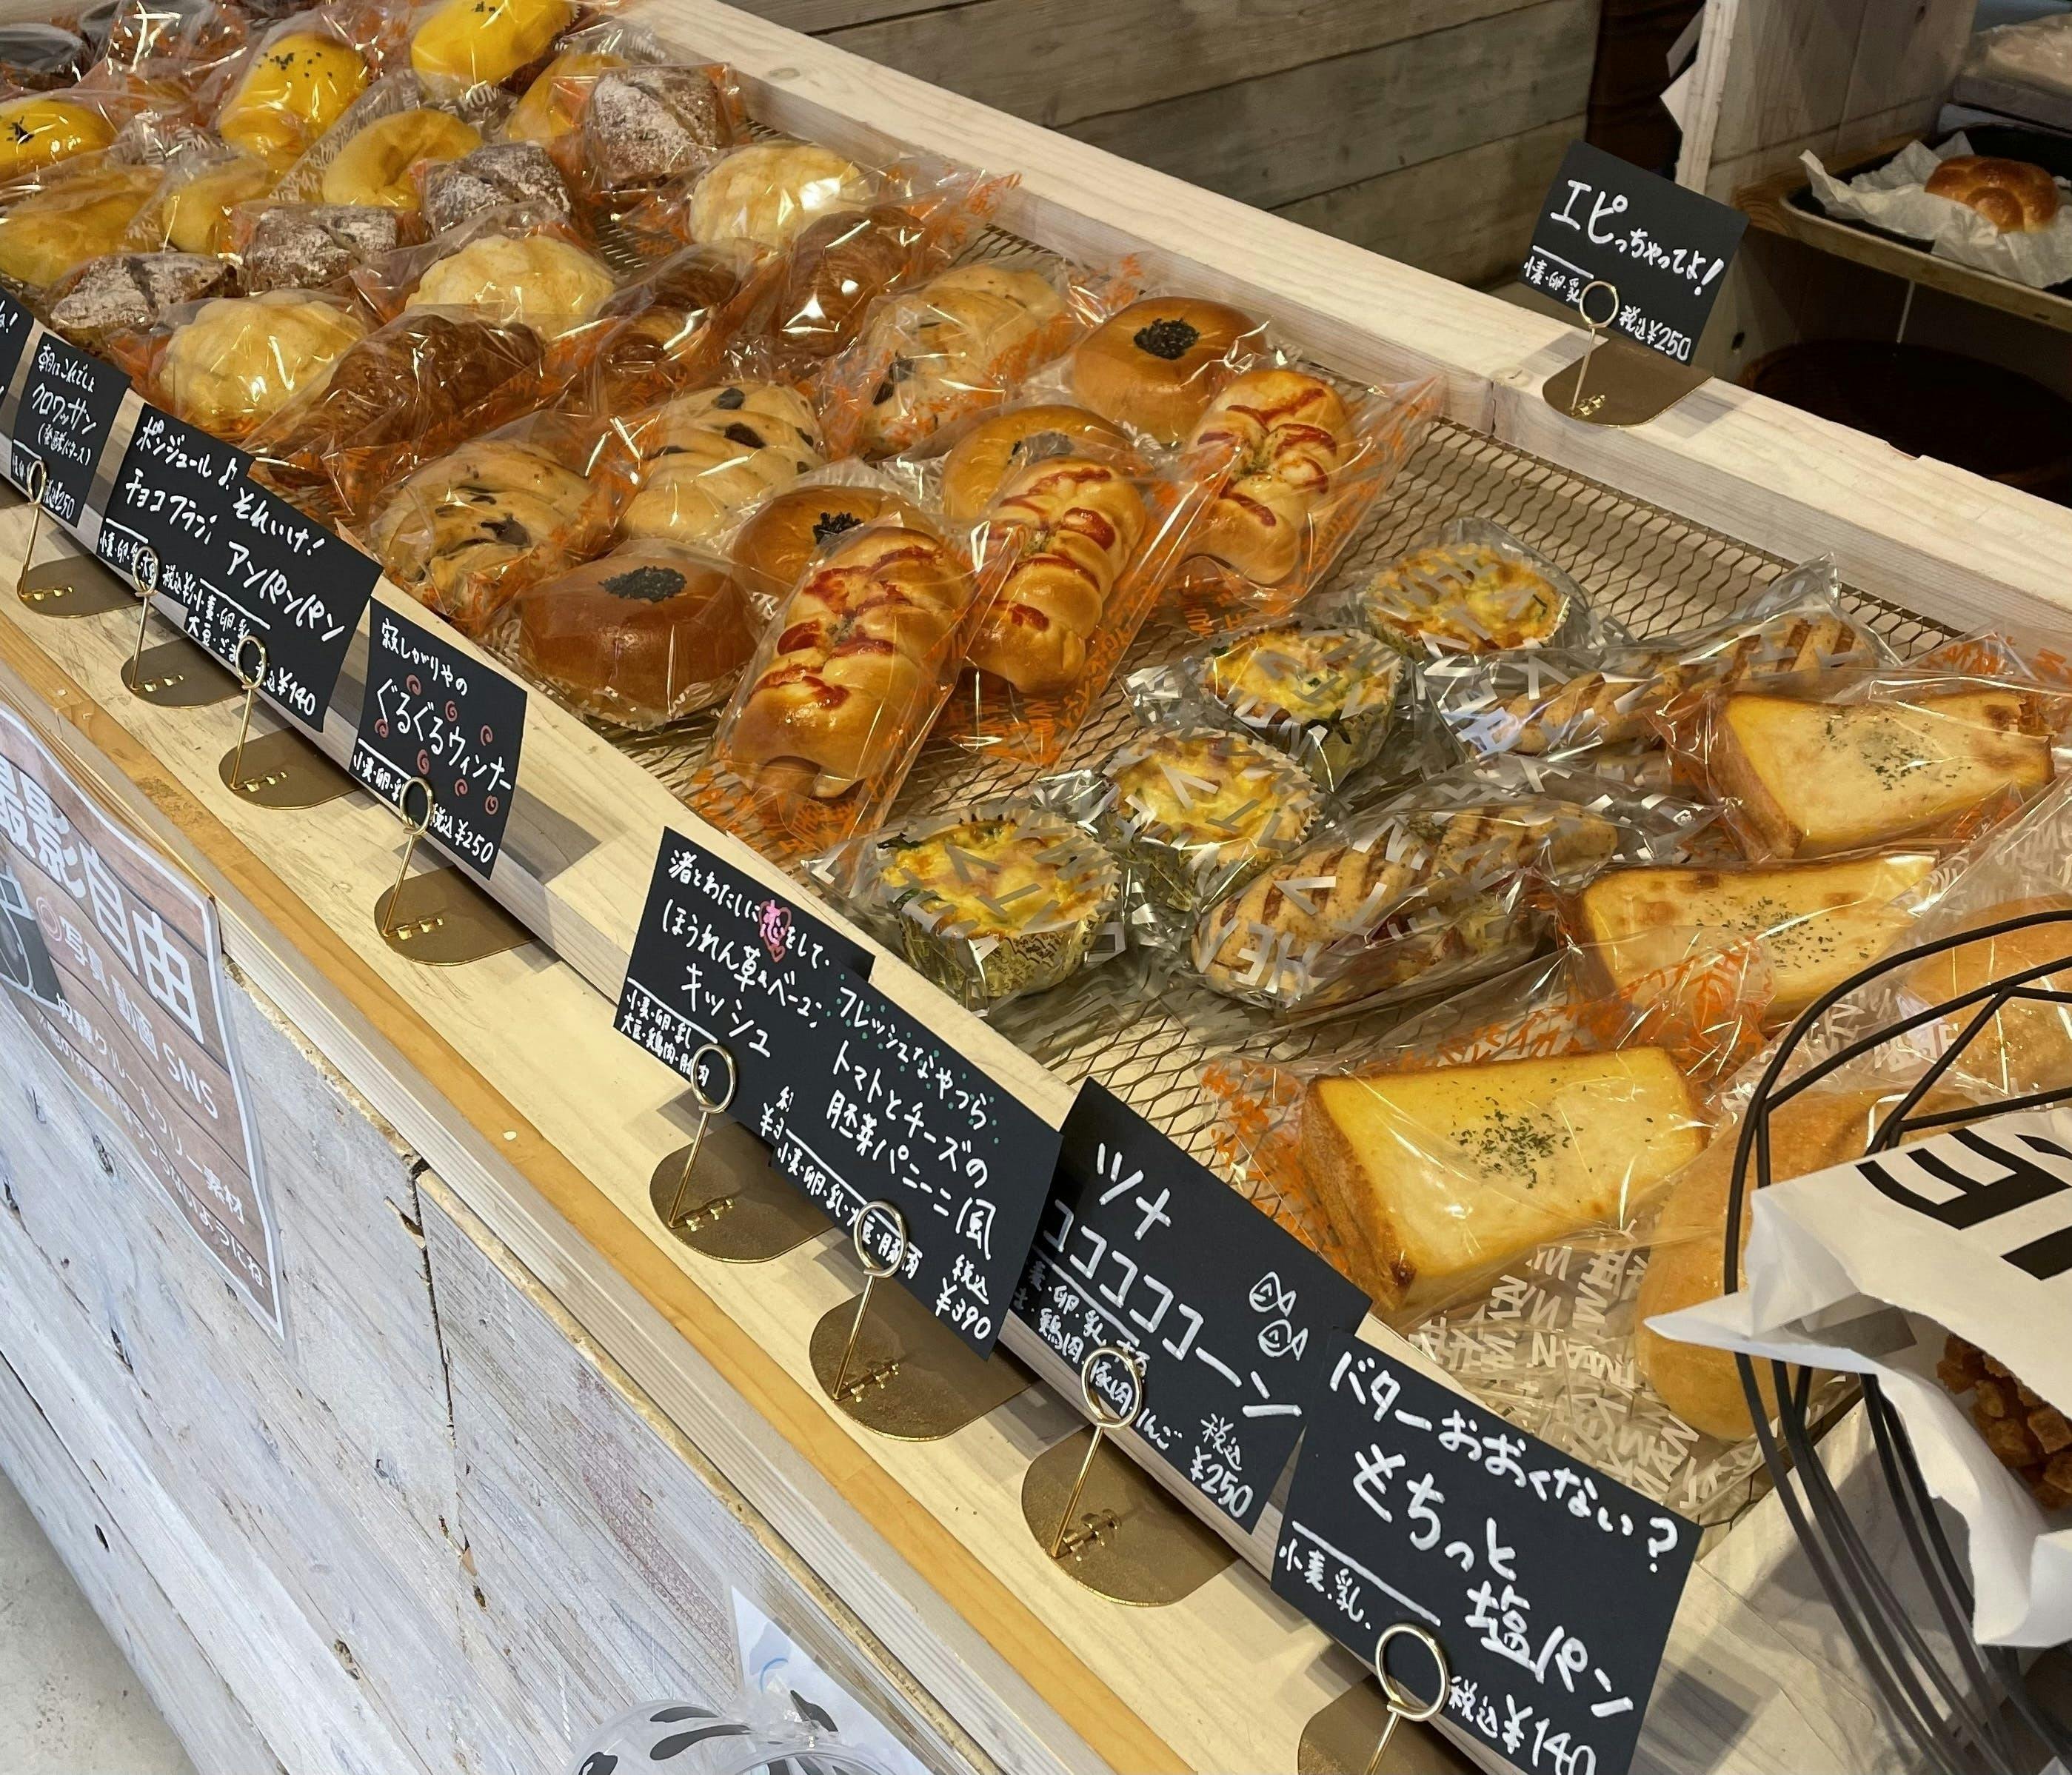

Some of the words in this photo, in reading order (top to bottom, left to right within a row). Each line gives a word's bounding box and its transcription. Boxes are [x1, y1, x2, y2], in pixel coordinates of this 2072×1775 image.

[1550, 179, 1724, 295] エピっちゃってよ!
[1619, 305, 1692, 361] 税込¥250
[33, 383, 97, 435] クロワッサン
[233, 487, 325, 555] それいけ!
[227, 541, 345, 642] アンパンパン
[381, 618, 468, 696] 寂しがりやの
[377, 678, 512, 791] ぐるぐるウィンナー
[59, 915, 110, 997] 写真
[112, 975, 160, 1062] 動画
[163, 1042, 218, 1120] SNS
[681, 963, 771, 1057] キッシュ
[840, 986, 987, 1130] フレッシュなやつら
[832, 1040, 989, 1189] トマトとチーズの
[1097, 1143, 1172, 1240] ツナ
[935, 1277, 992, 1340] ¥390
[952, 1254, 989, 1305] 税込
[1043, 1199, 1303, 1417] コココココーン
[1190, 1445, 1254, 1519] ¥250
[1202, 1413, 1242, 1471] 税込
[1330, 1351, 1677, 1573] バターおおくない?
[1465, 1580, 1634, 1717] 塩パン
